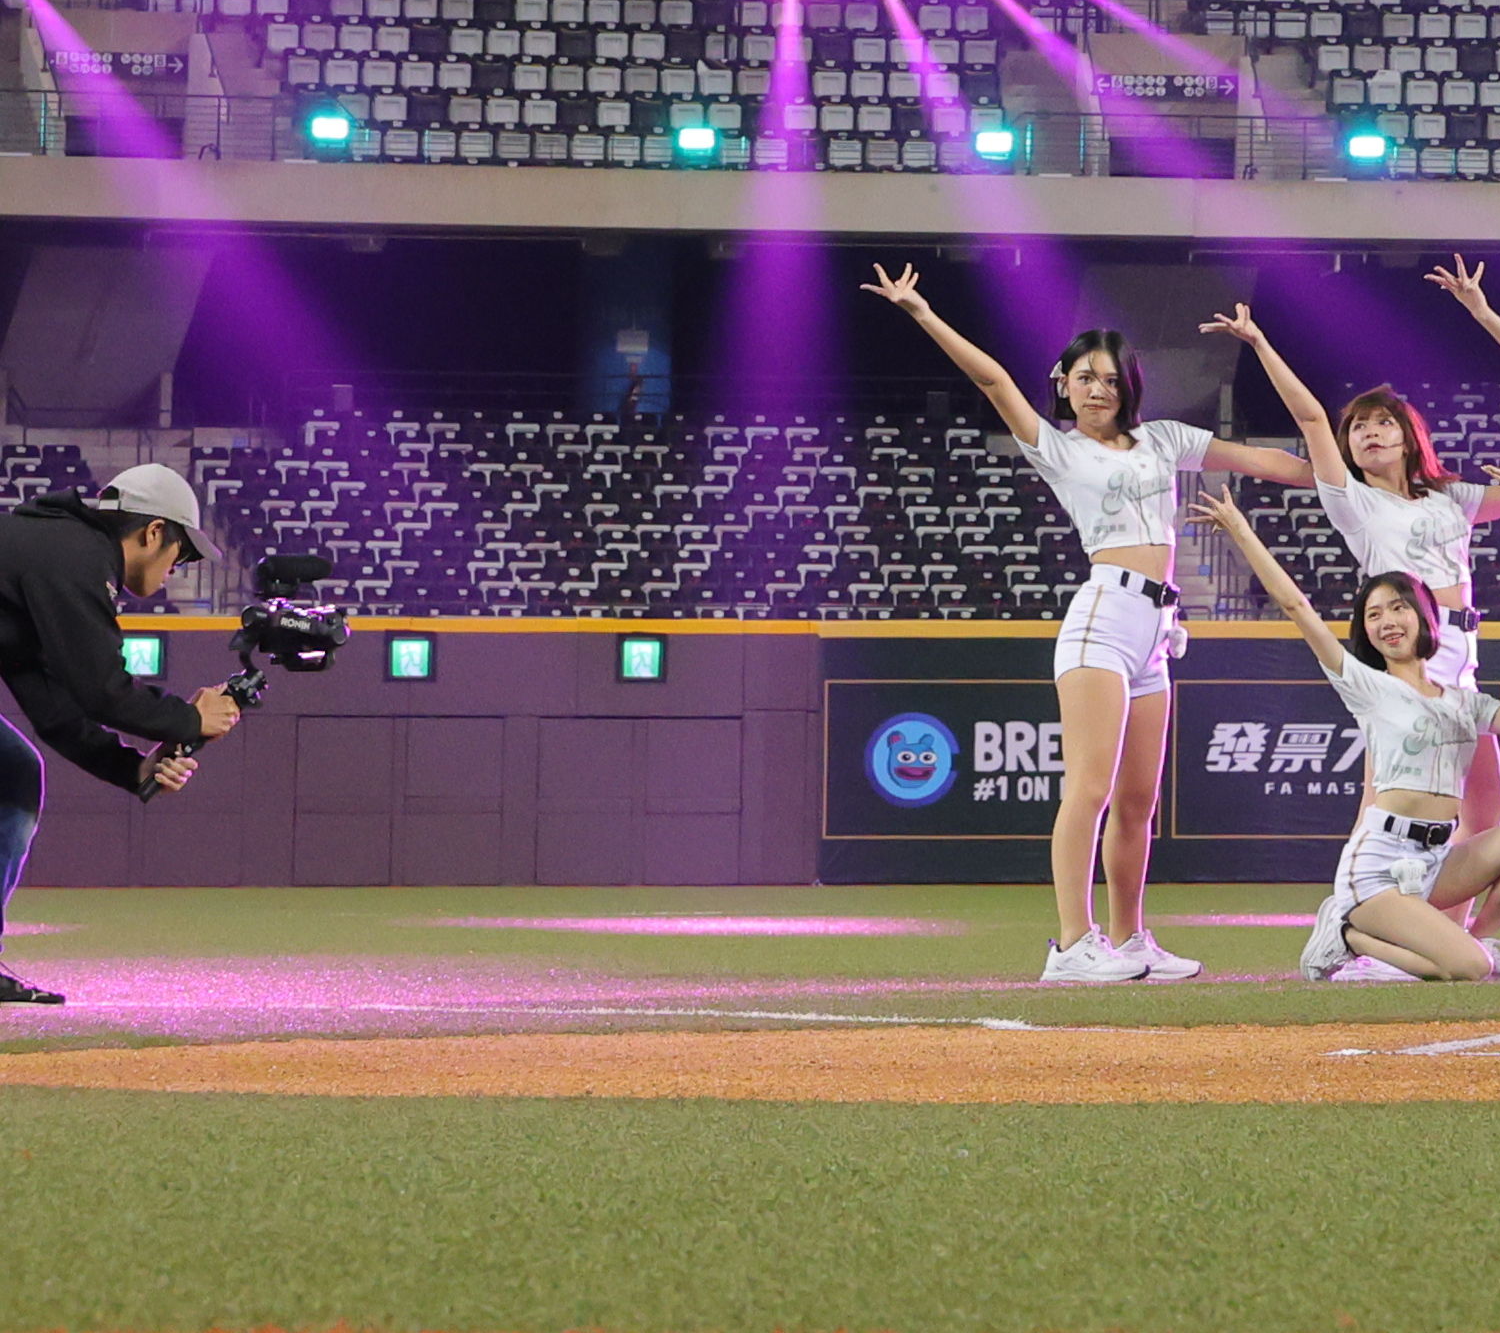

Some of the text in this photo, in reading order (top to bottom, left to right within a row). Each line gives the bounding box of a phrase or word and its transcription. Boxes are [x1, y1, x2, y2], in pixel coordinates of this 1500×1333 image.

[280, 616, 311, 630] RONIN
[973, 776, 1049, 801] #1 ON
[1264, 781, 1364, 796] FA MAS
